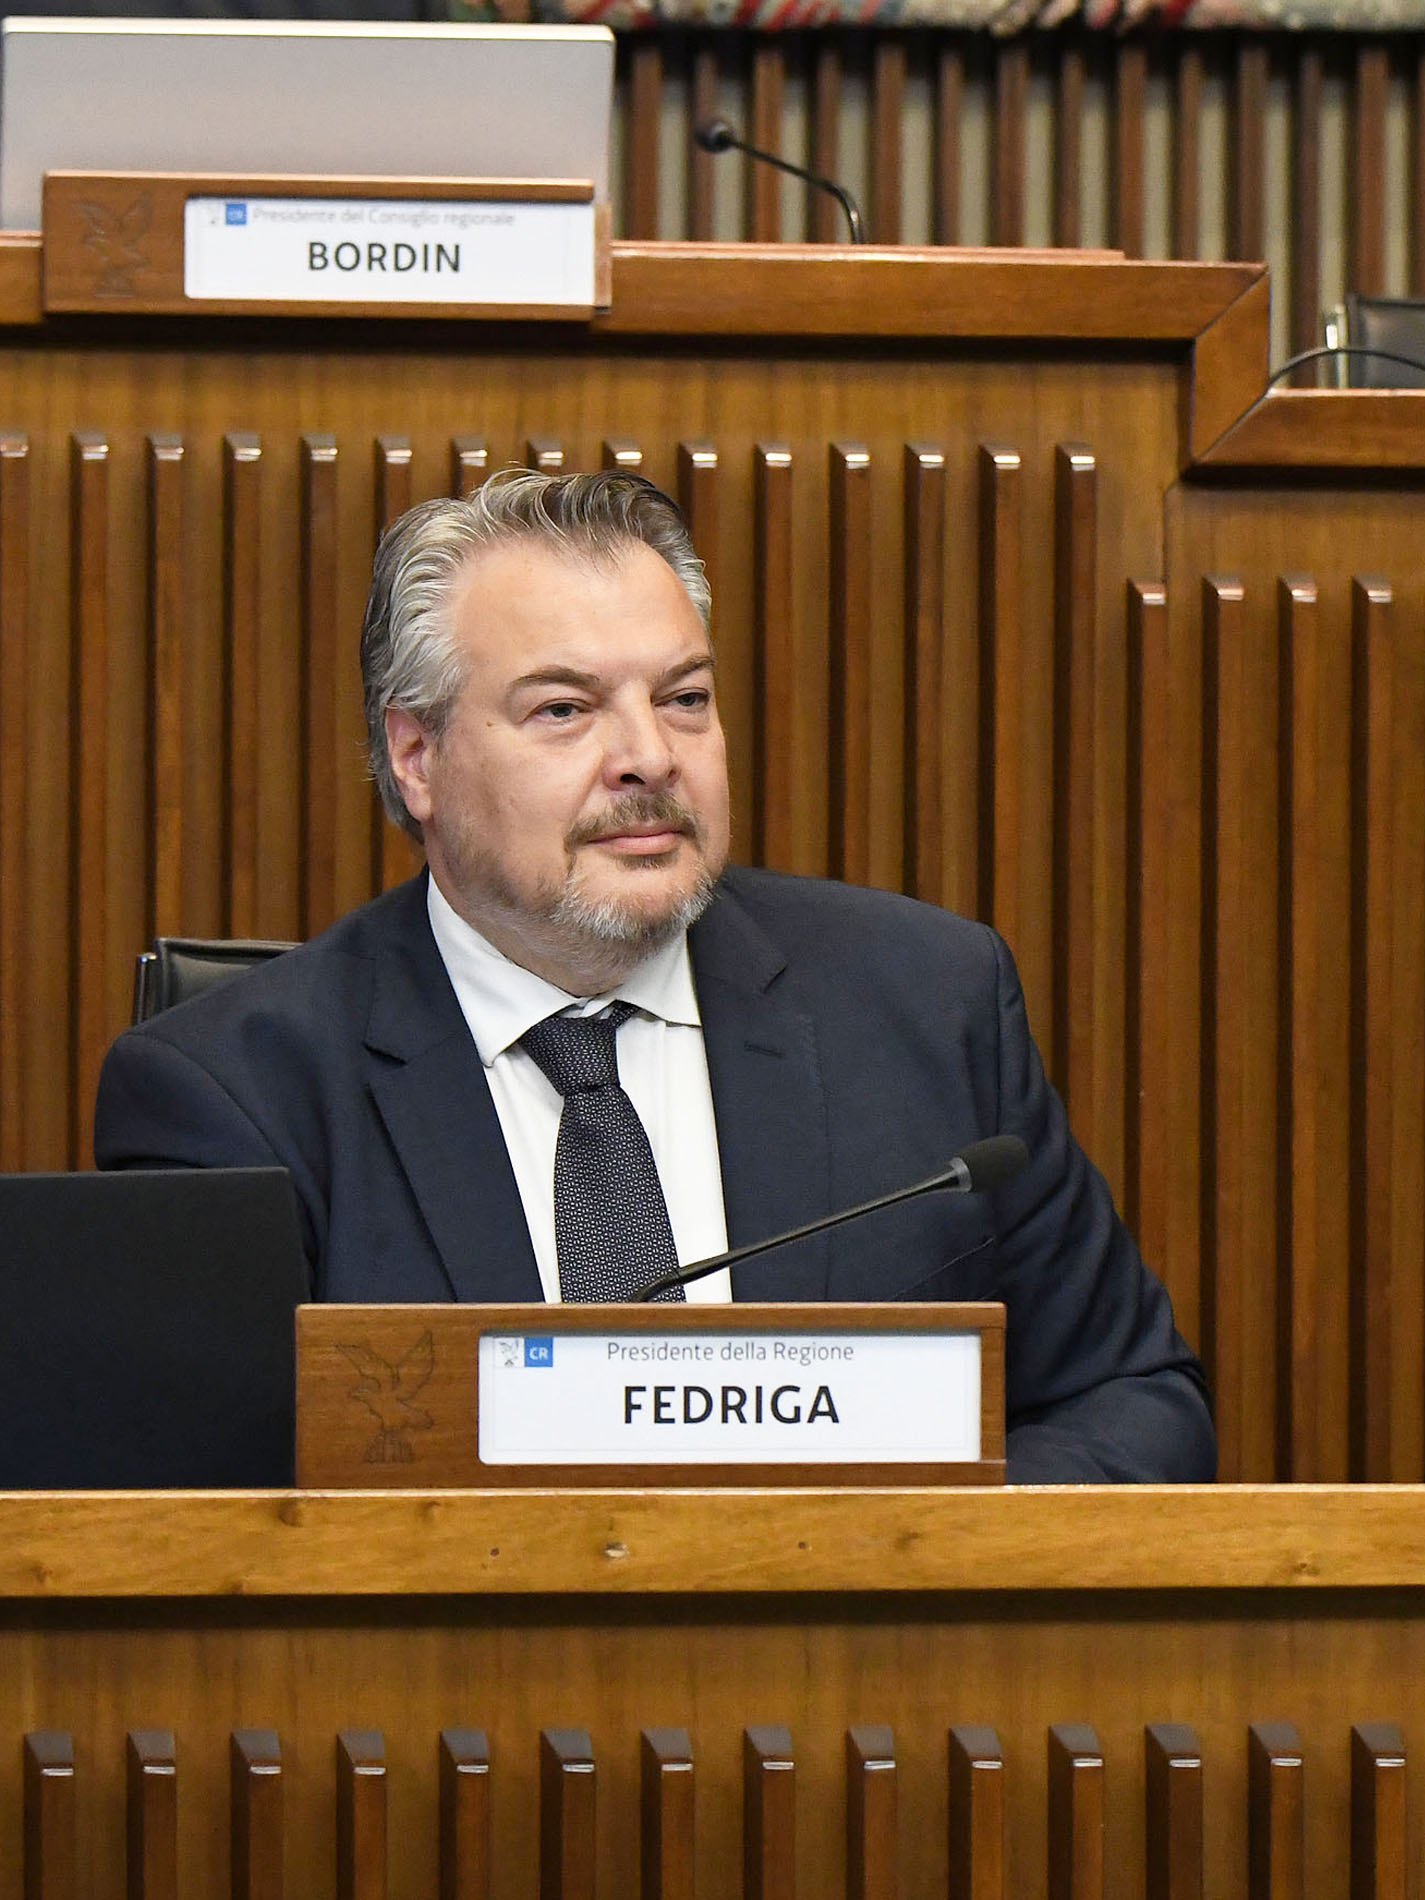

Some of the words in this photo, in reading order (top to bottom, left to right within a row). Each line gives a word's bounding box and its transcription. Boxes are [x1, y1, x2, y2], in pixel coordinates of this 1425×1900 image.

[253, 207, 334, 224] Presidente
[342, 208, 364, 224] del
[369, 208, 440, 229] Consiglio
[444, 210, 515, 230] regionale
[308, 242, 461, 273] BORDIN
[529, 1347, 548, 1359] CR
[607, 1343, 714, 1361] Presidente
[720, 1343, 767, 1361] della
[774, 1343, 854, 1366] Regione
[624, 1385, 840, 1424] FEDRIGA
